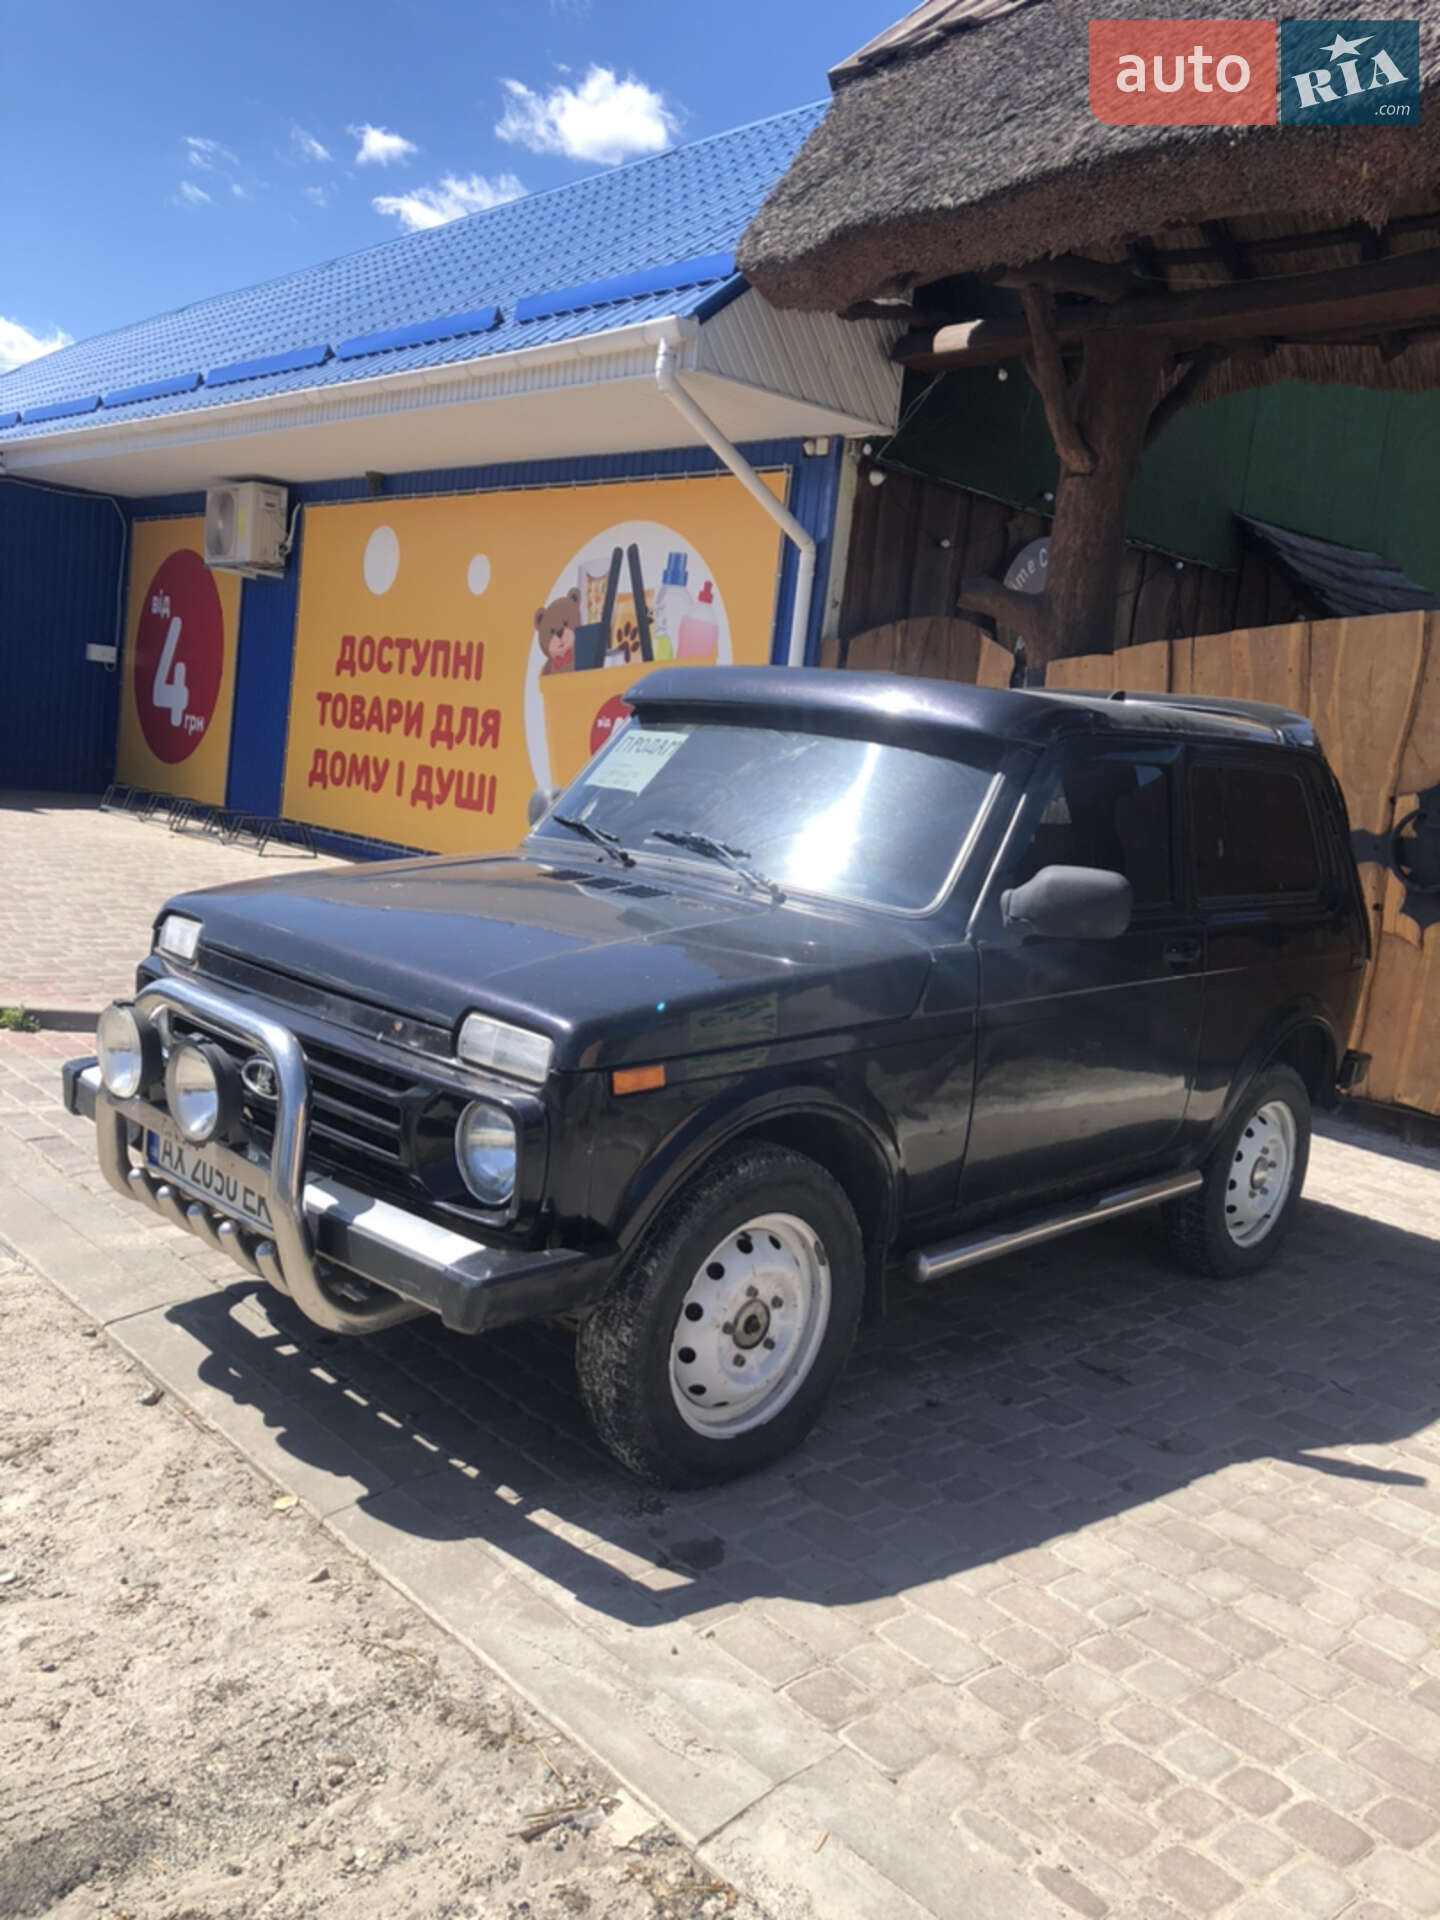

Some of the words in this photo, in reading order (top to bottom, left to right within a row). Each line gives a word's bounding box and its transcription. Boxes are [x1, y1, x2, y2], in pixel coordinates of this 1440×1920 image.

[151, 589, 171, 618] від
[152, 616, 190, 727] 4
[335, 635, 485, 682] ДОСТУПНІ
[184, 714, 205, 735] грн
[316, 692, 424, 739] ТОВАРИ
[430, 704, 501, 751] ДЛЯ
[308, 748, 390, 794] ДОМУ
[410, 764, 498, 815] ДУШІ
